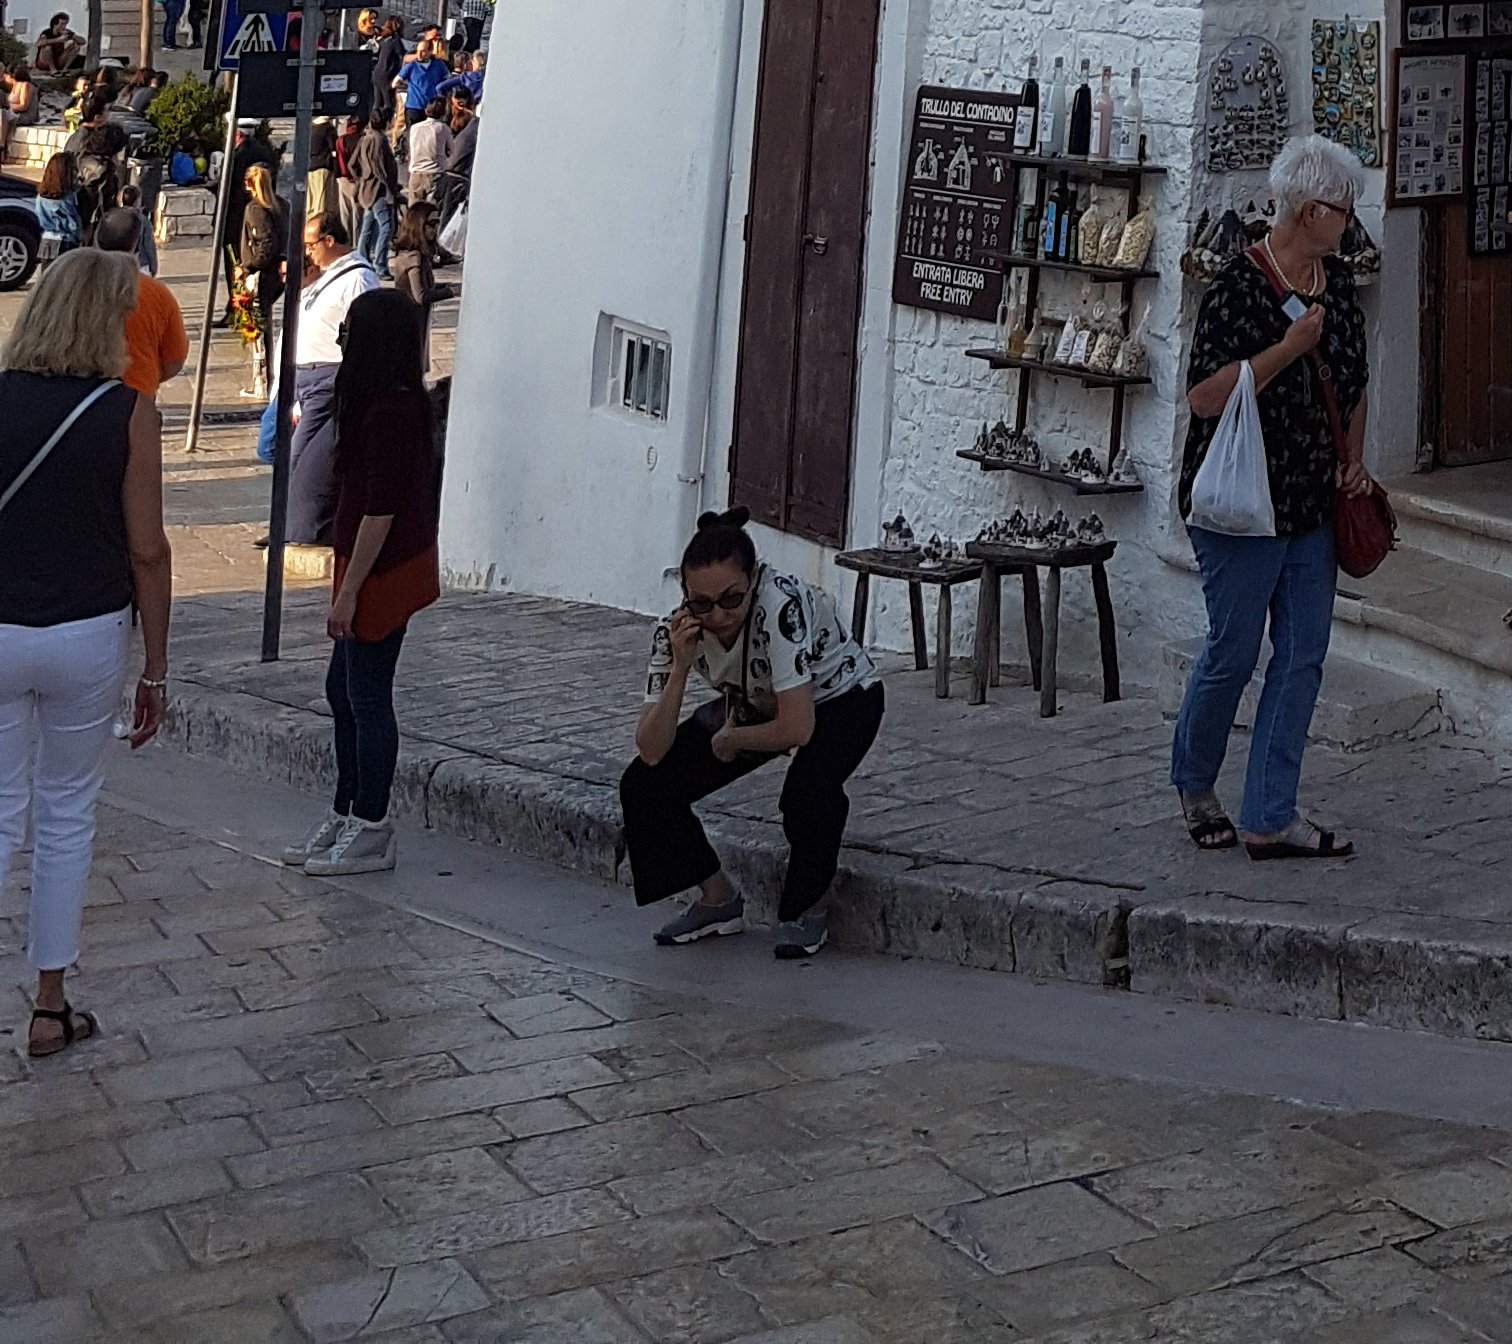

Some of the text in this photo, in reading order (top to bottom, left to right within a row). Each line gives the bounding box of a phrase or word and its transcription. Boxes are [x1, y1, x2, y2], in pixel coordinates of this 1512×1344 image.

[921, 97, 950, 116] TRULLO
[950, 100, 965, 118] DEL
[966, 102, 1014, 123] CONTADINO
[912, 261, 985, 290] ENTRATA LIBERA
[920, 281, 973, 307] FREE ENTRY
